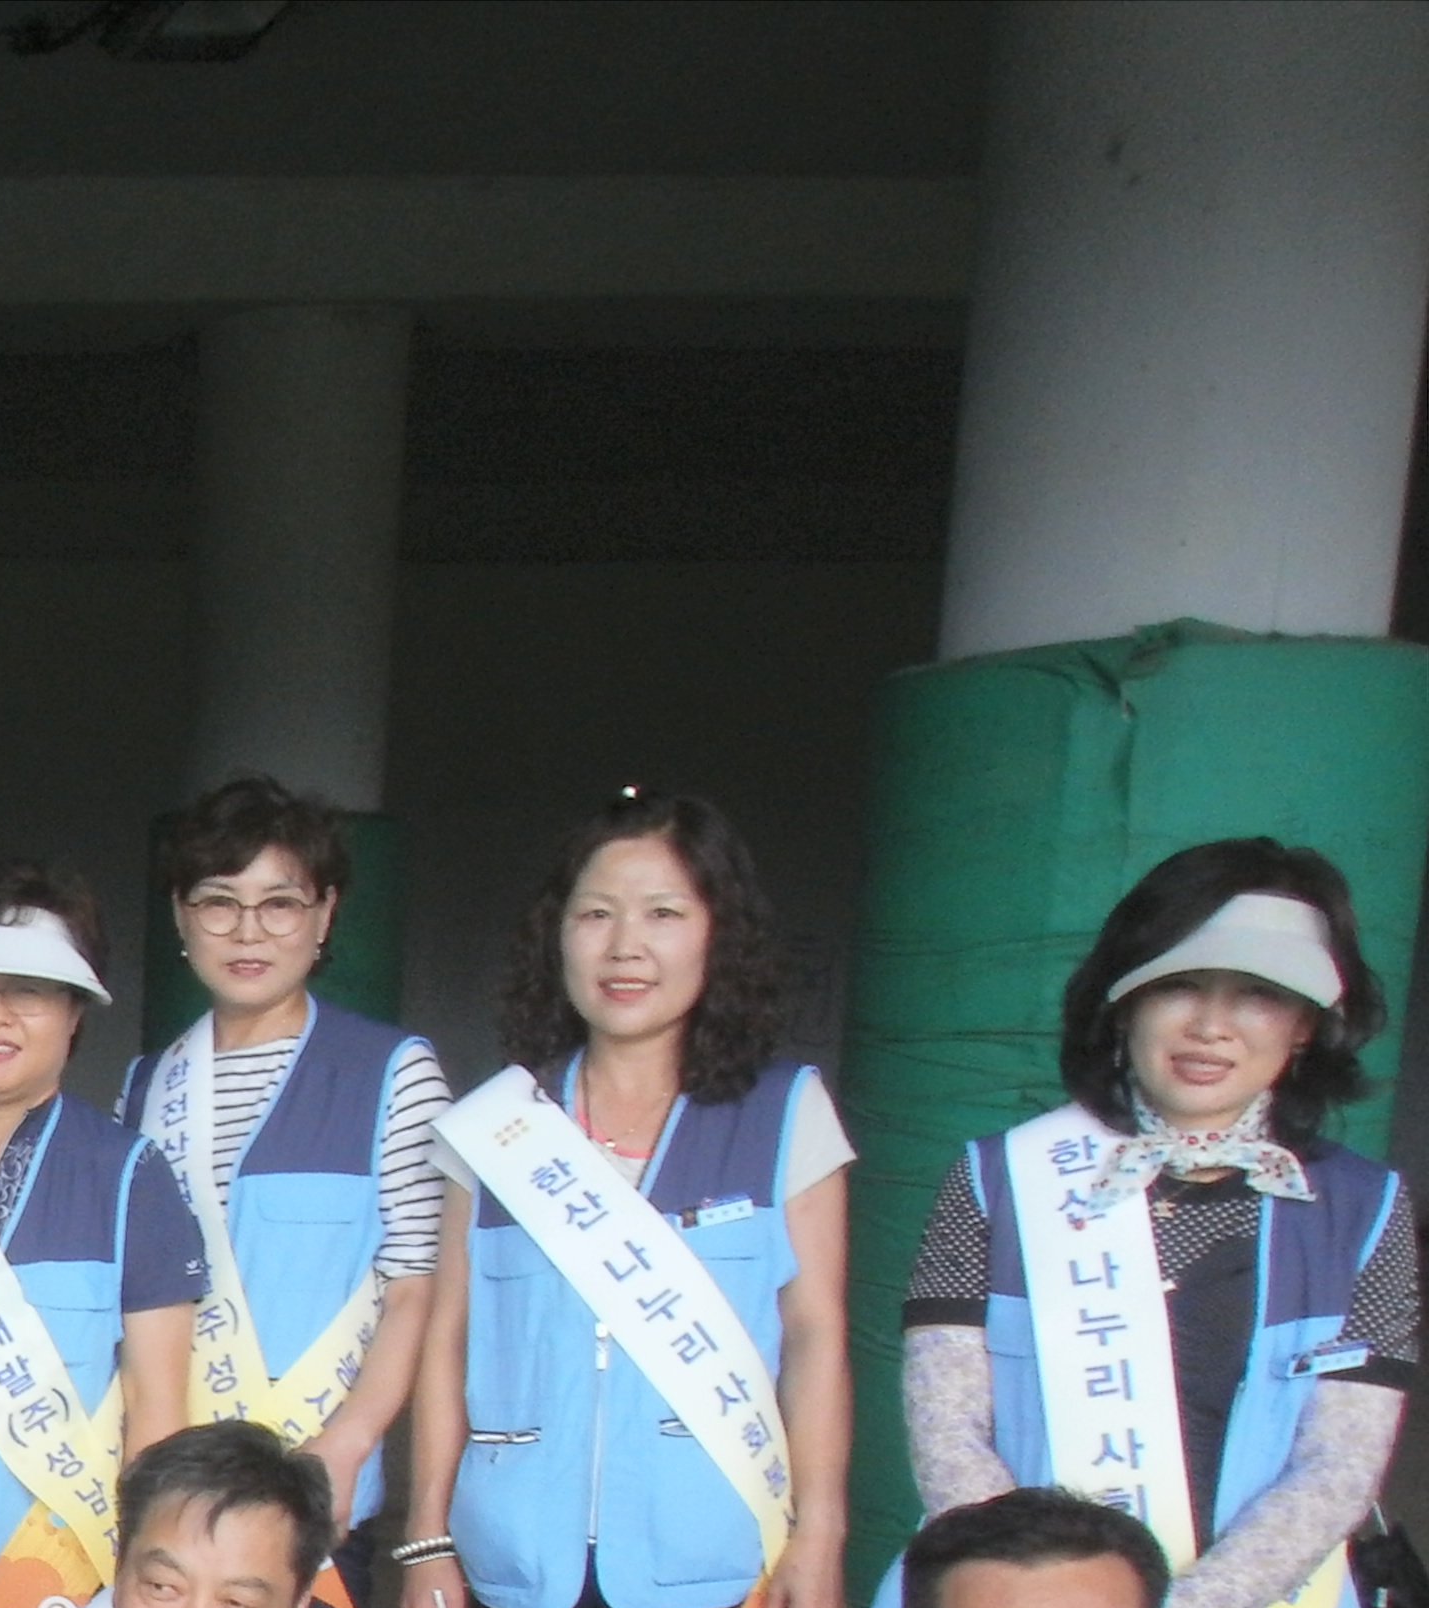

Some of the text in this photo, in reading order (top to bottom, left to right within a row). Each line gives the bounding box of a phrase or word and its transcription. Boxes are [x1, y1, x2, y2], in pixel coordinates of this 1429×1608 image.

[529, 1156, 796, 1530] 한산 나누리 사회봉
[1067, 1251, 1134, 1403] 나누리
